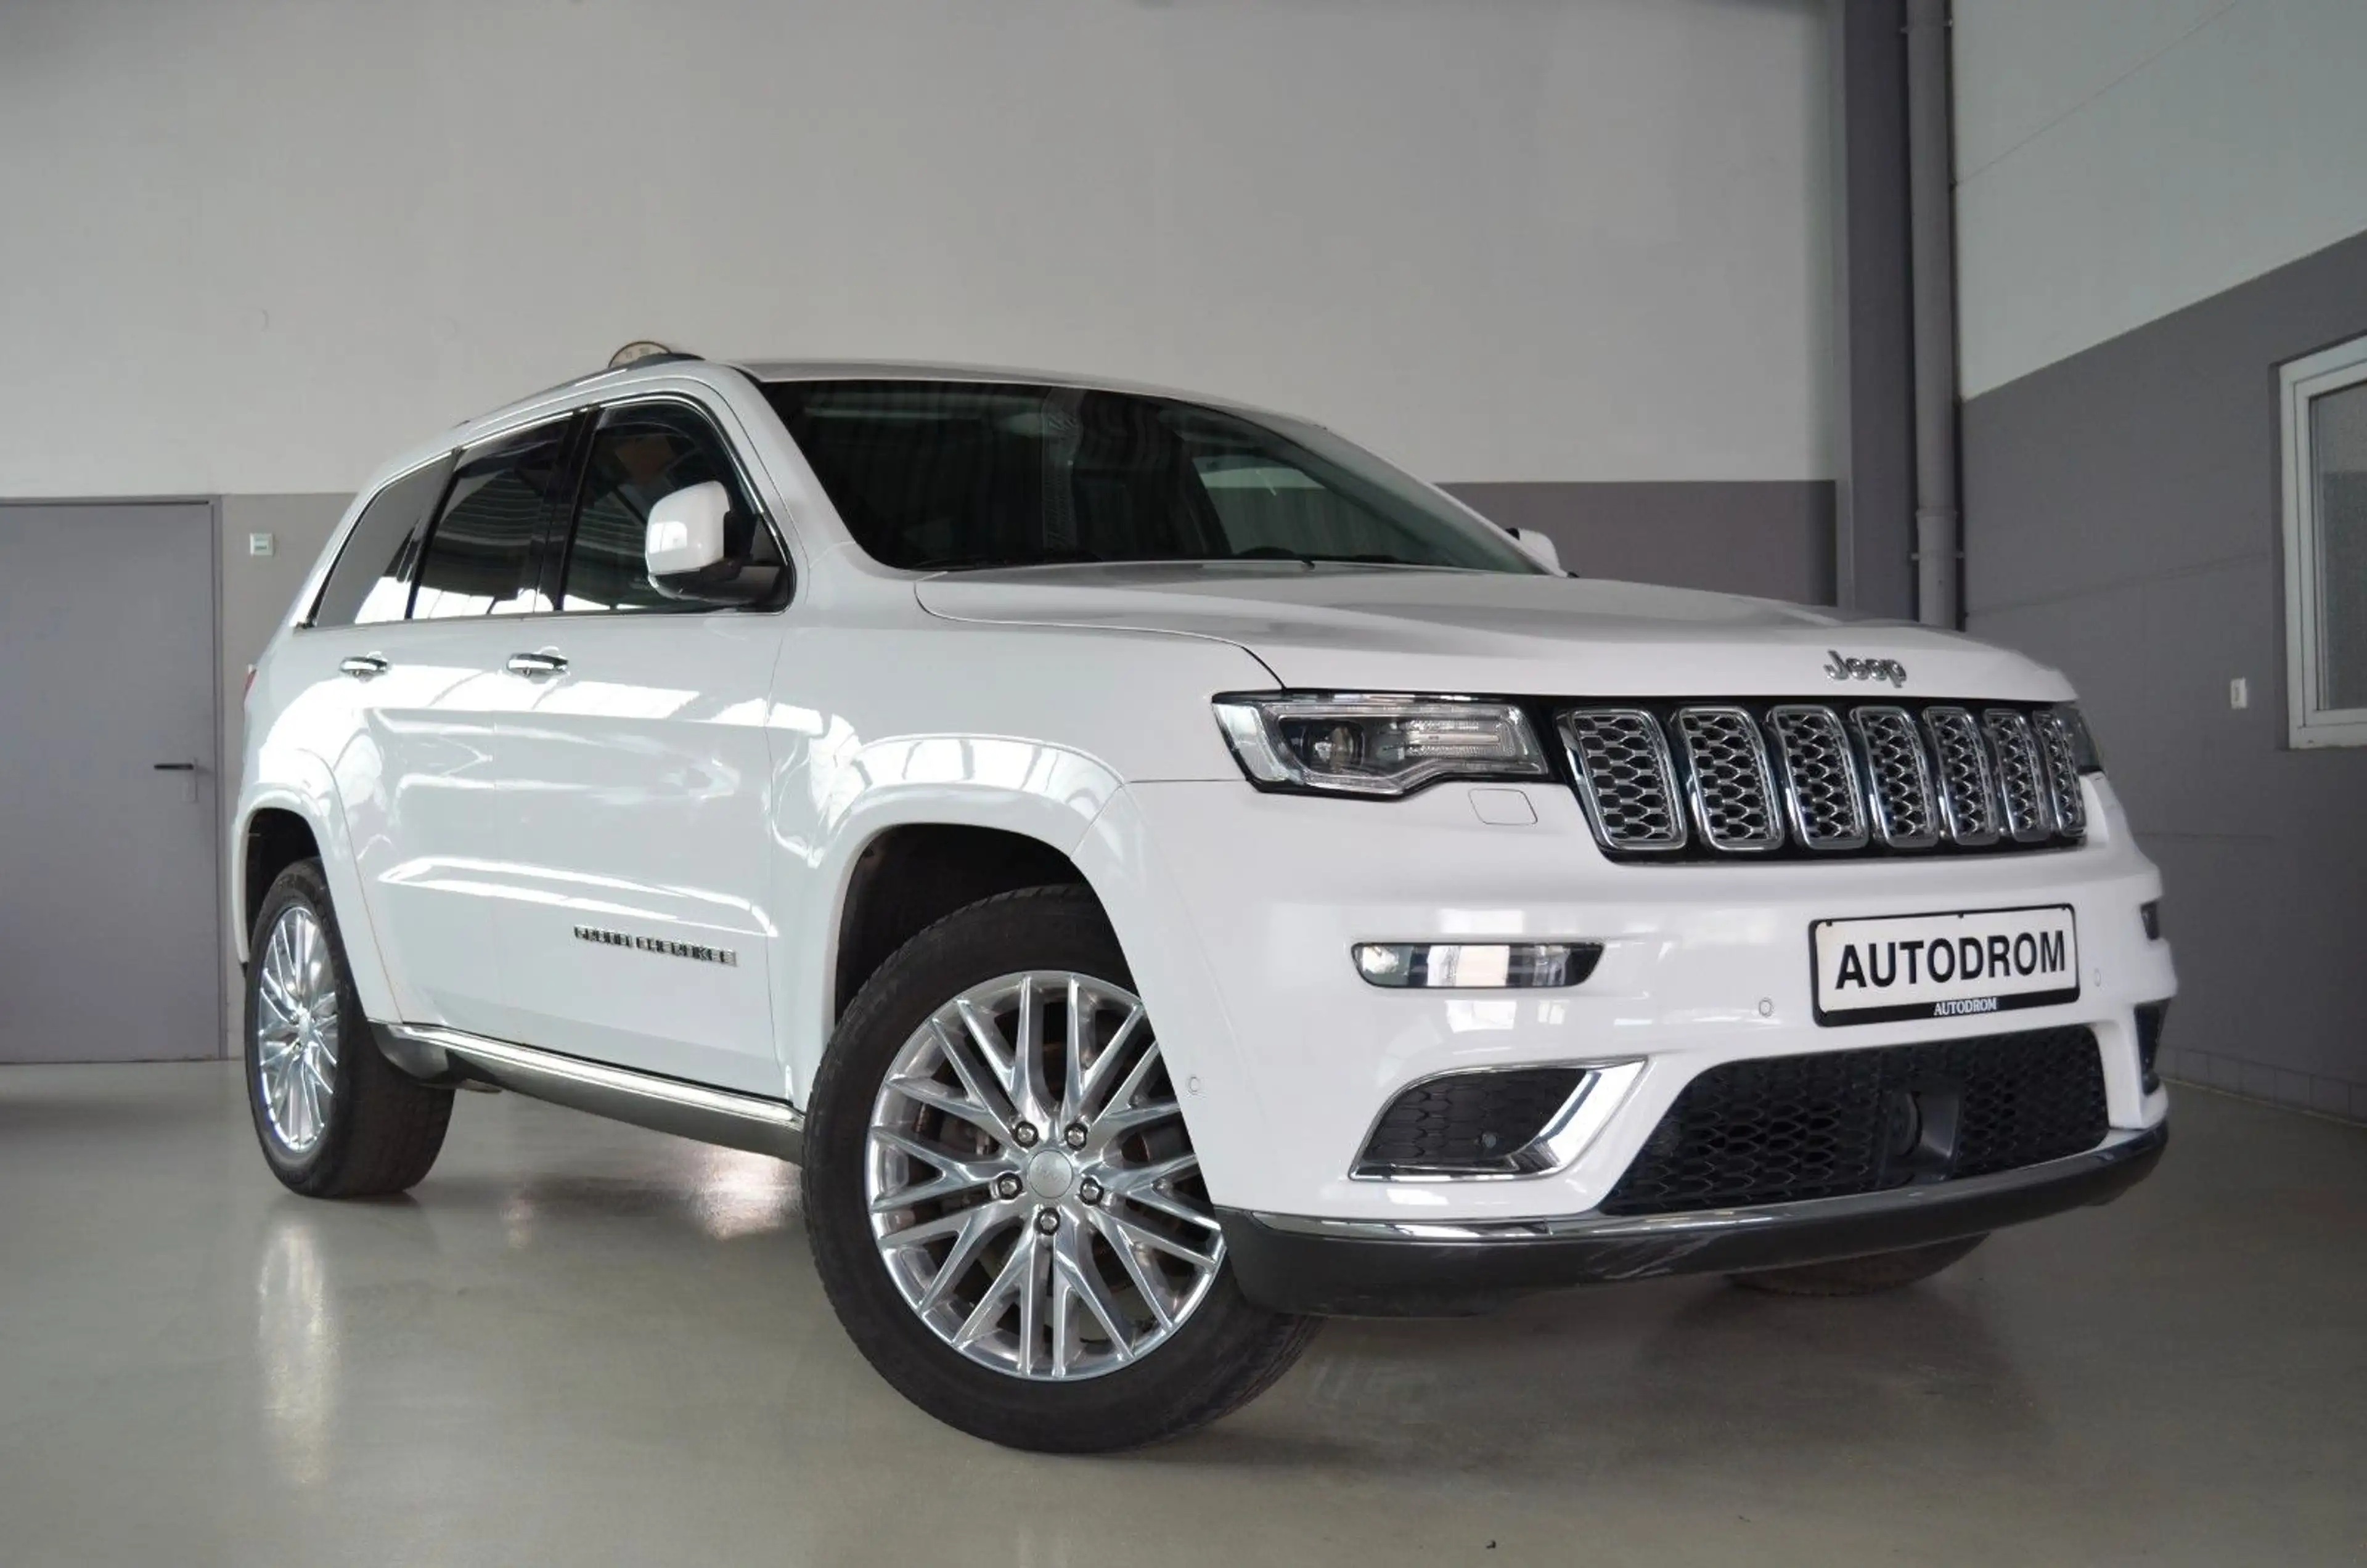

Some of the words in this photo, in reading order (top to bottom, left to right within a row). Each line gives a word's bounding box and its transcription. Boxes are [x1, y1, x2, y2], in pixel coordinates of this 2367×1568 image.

[1823, 649, 1907, 688] Jeep
[1835, 929, 2066, 990] AUTODROM
[1933, 997, 1997, 1016] AUTODROM
